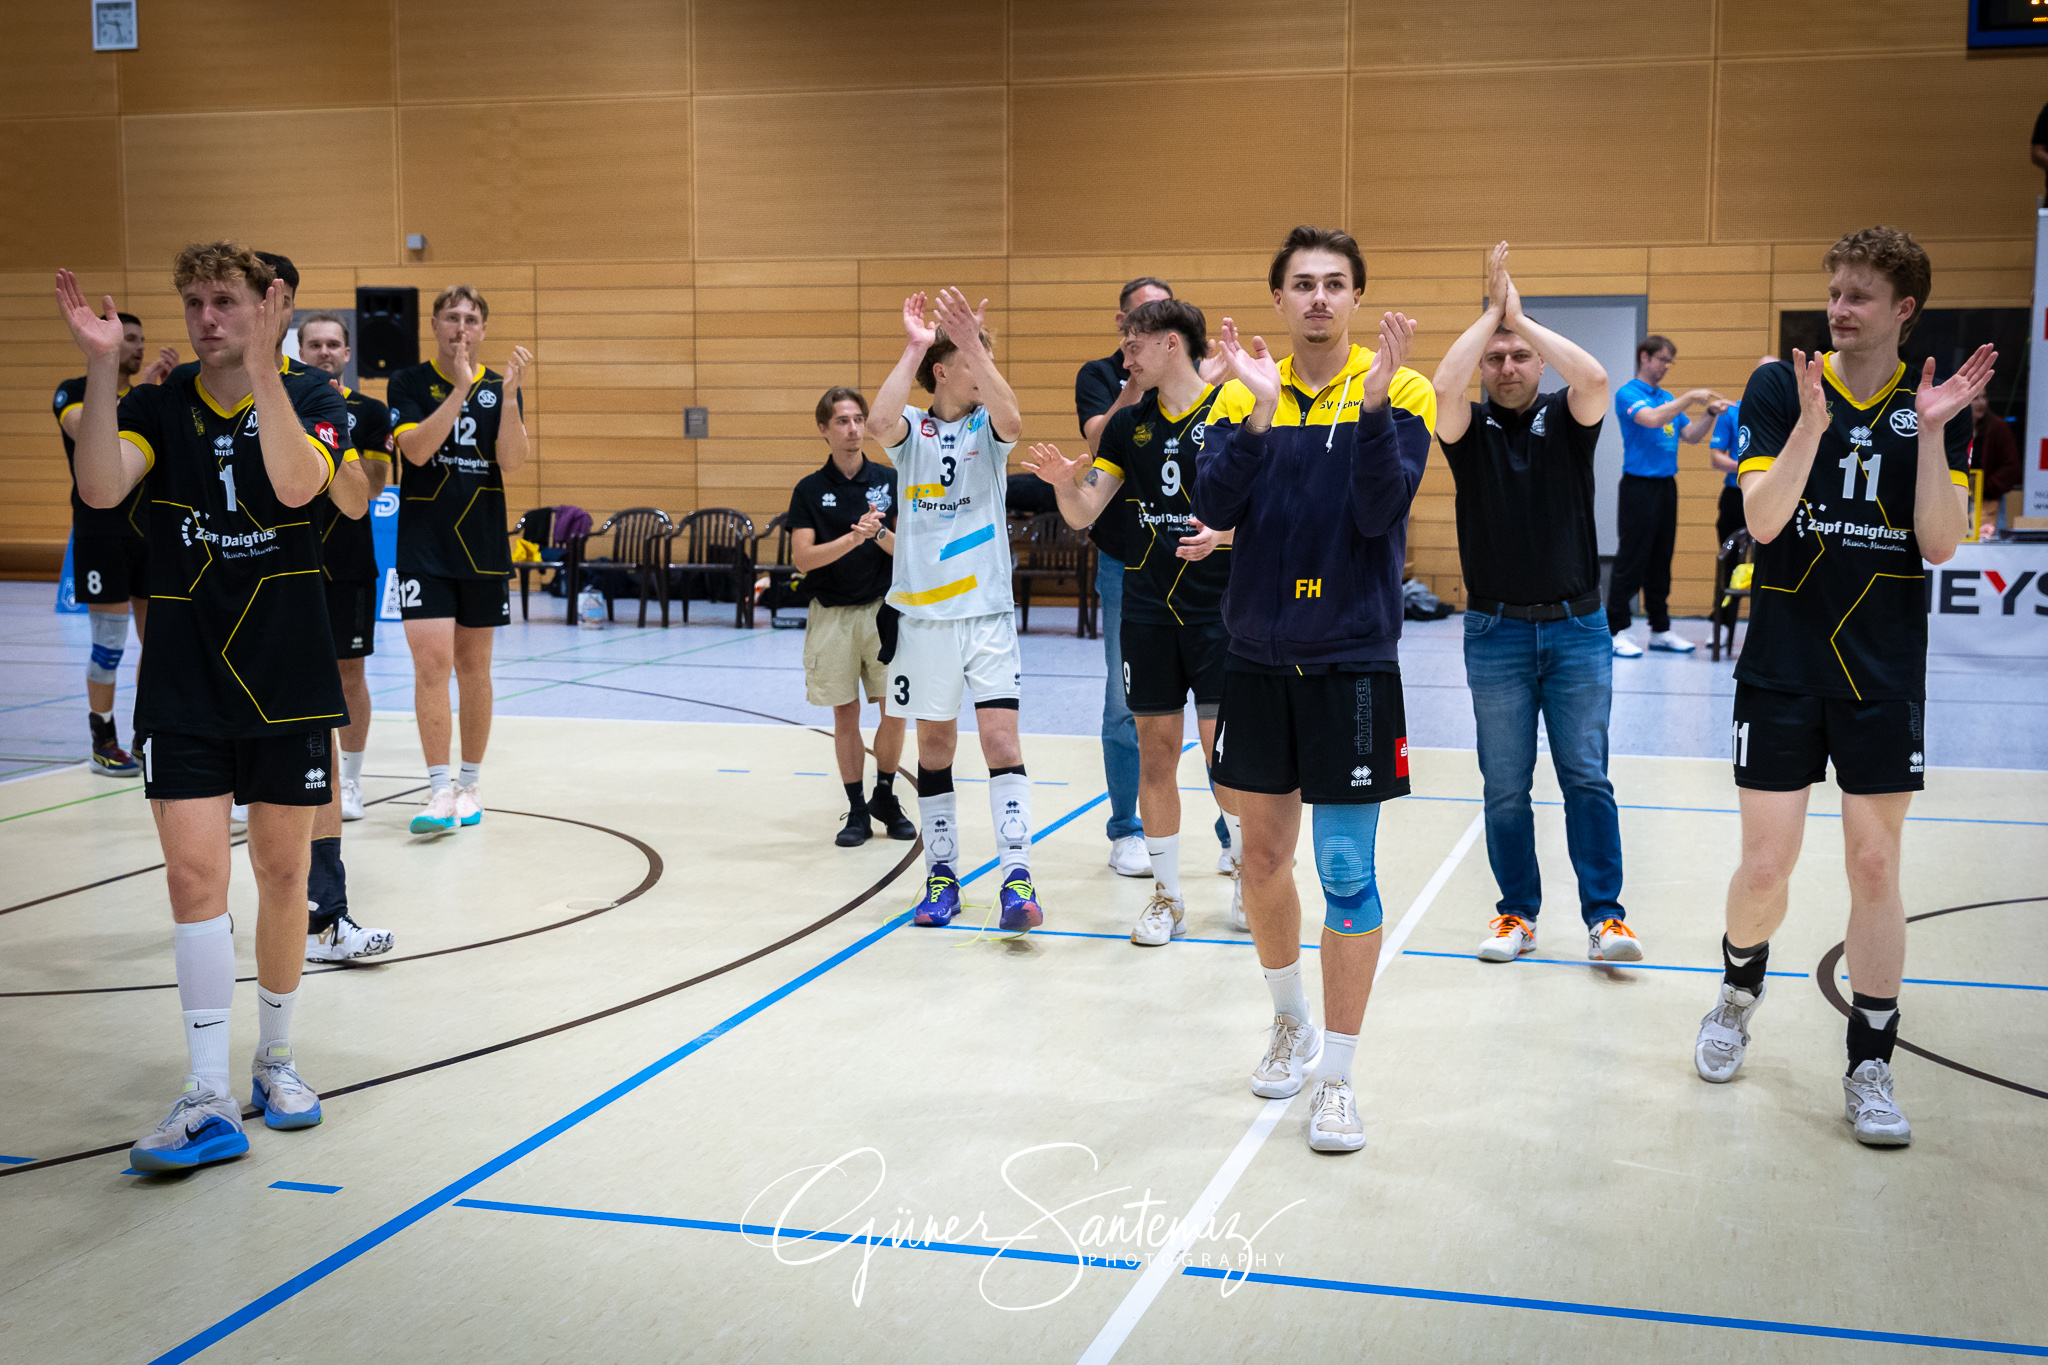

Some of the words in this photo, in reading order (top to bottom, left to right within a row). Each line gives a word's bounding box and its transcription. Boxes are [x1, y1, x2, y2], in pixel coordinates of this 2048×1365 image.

[453, 416, 477, 446] 12
[940, 456, 957, 487] 3
[1161, 460, 1181, 497] 9
[1838, 451, 1882, 502] 11
[219, 464, 238, 512] 1
[918, 499, 937, 511] Zapf
[1807, 518, 1842, 534] Zapf
[1843, 522, 1908, 540] Daigfuss
[87, 569, 103, 595] 8
[399, 579, 422, 608] 12
[1295, 578, 1322, 599] FH
[894, 674, 910, 706] 3
[142, 736, 153, 783] 1
[1732, 720, 1750, 768] 11
